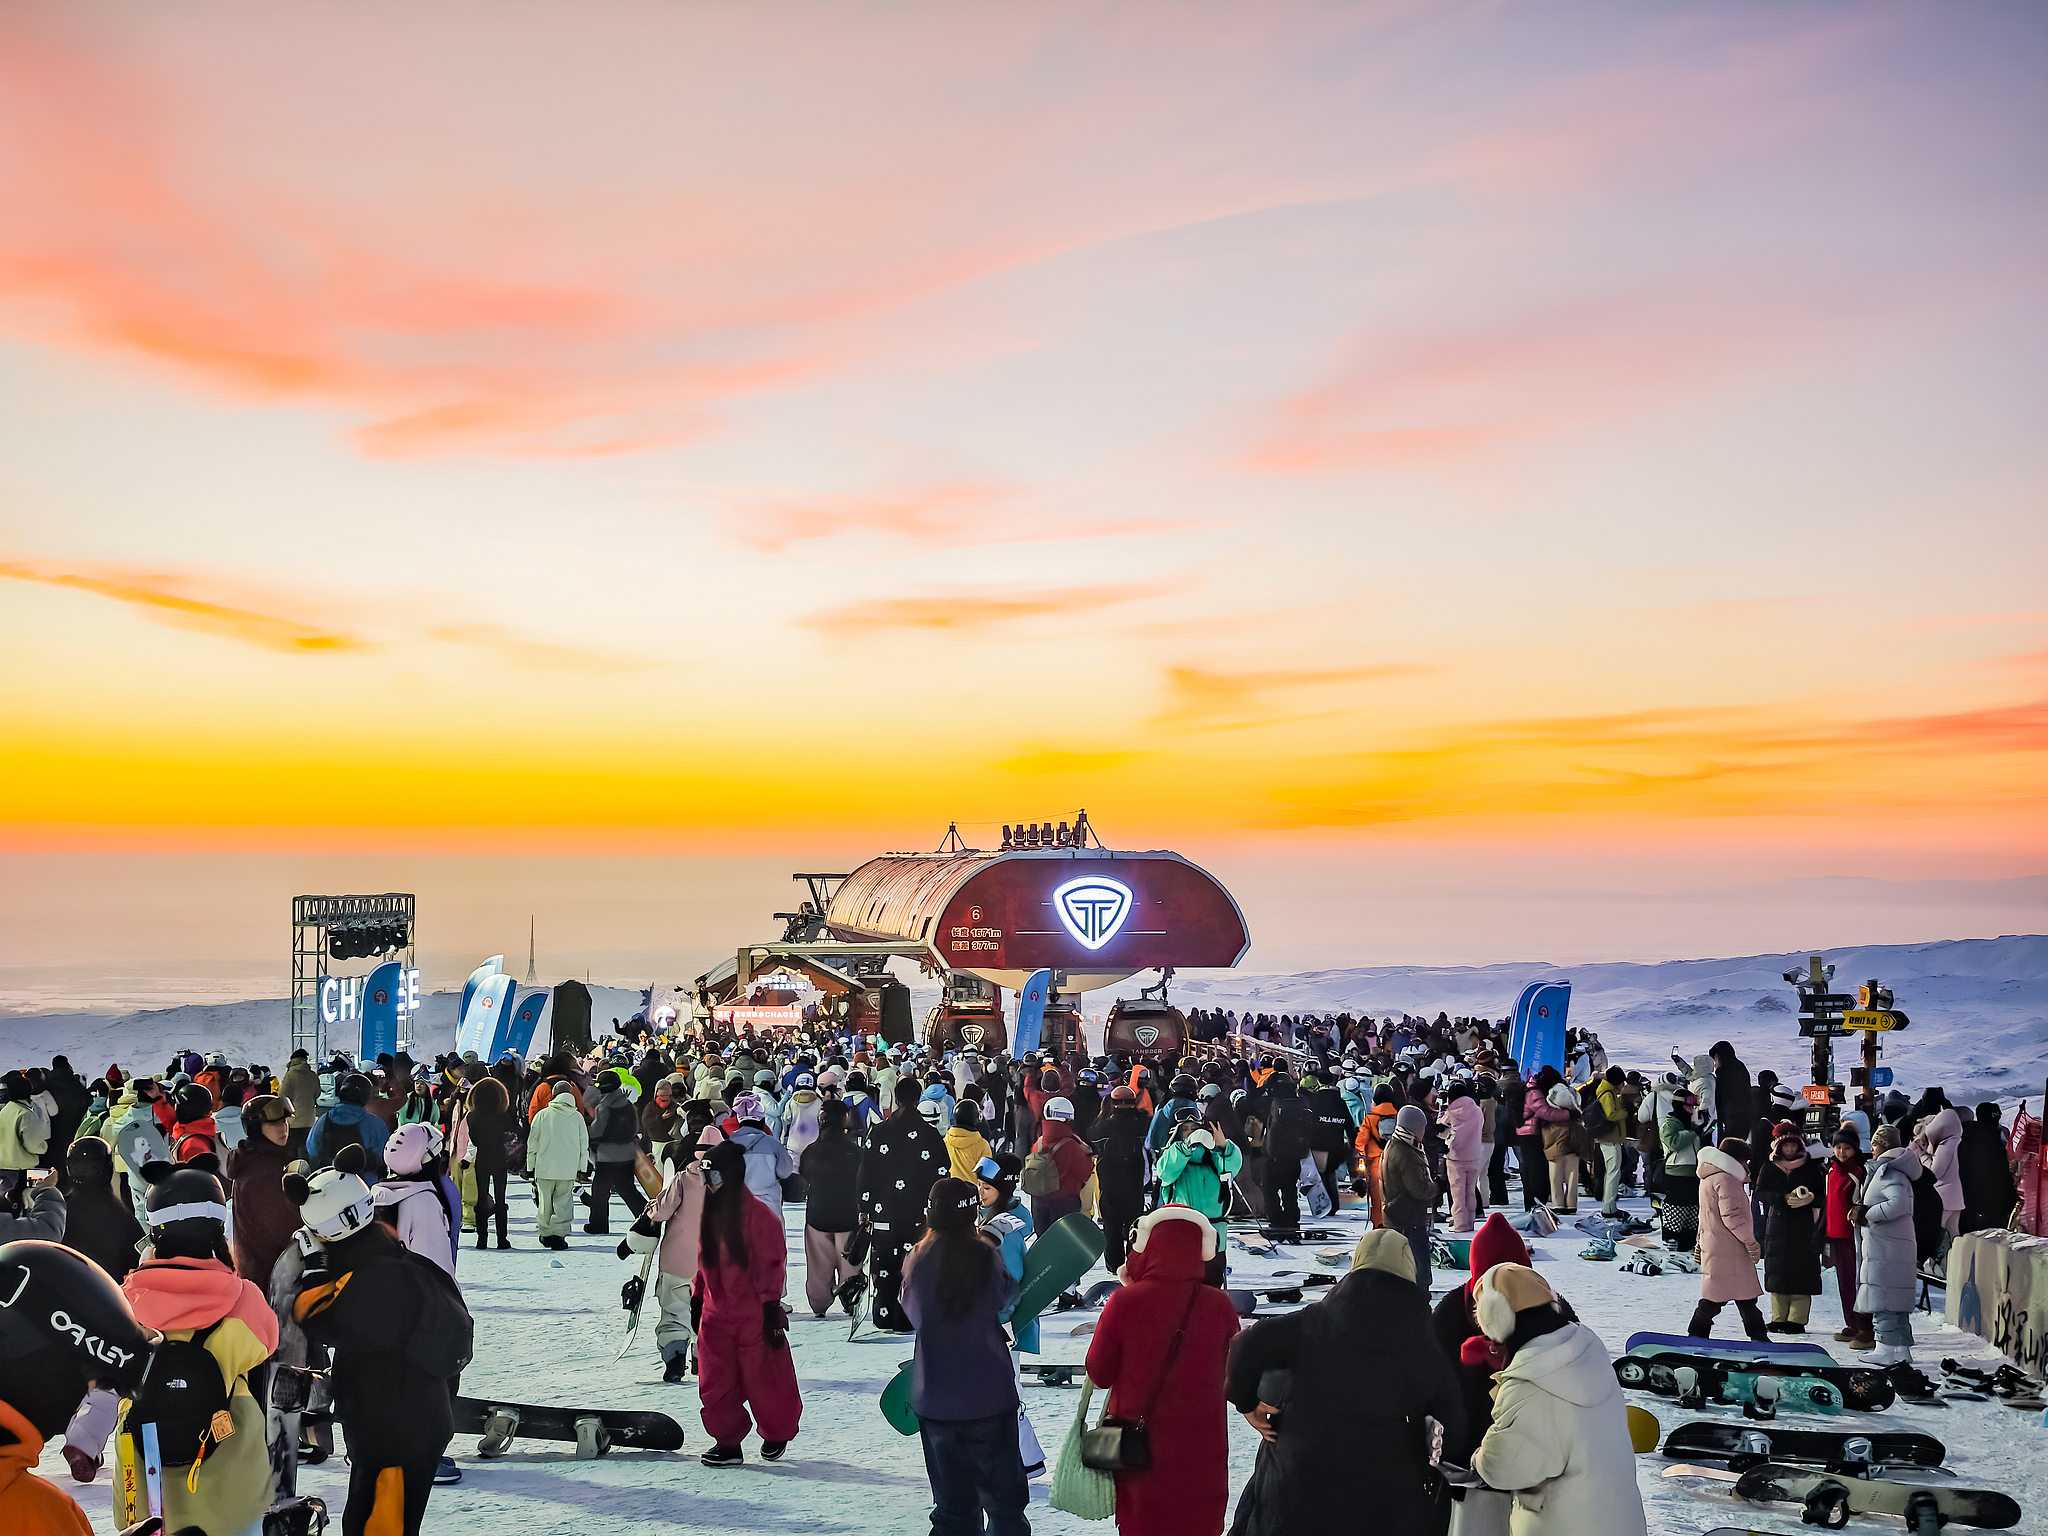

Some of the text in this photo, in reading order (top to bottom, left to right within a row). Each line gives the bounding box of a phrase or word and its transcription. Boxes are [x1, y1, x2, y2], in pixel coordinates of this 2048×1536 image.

[972, 909, 980, 920] 6
[952, 927, 1001, 937] 长度 1671m
[971, 941, 999, 950] 377m
[50, 1310, 135, 1368] OAKLEY
